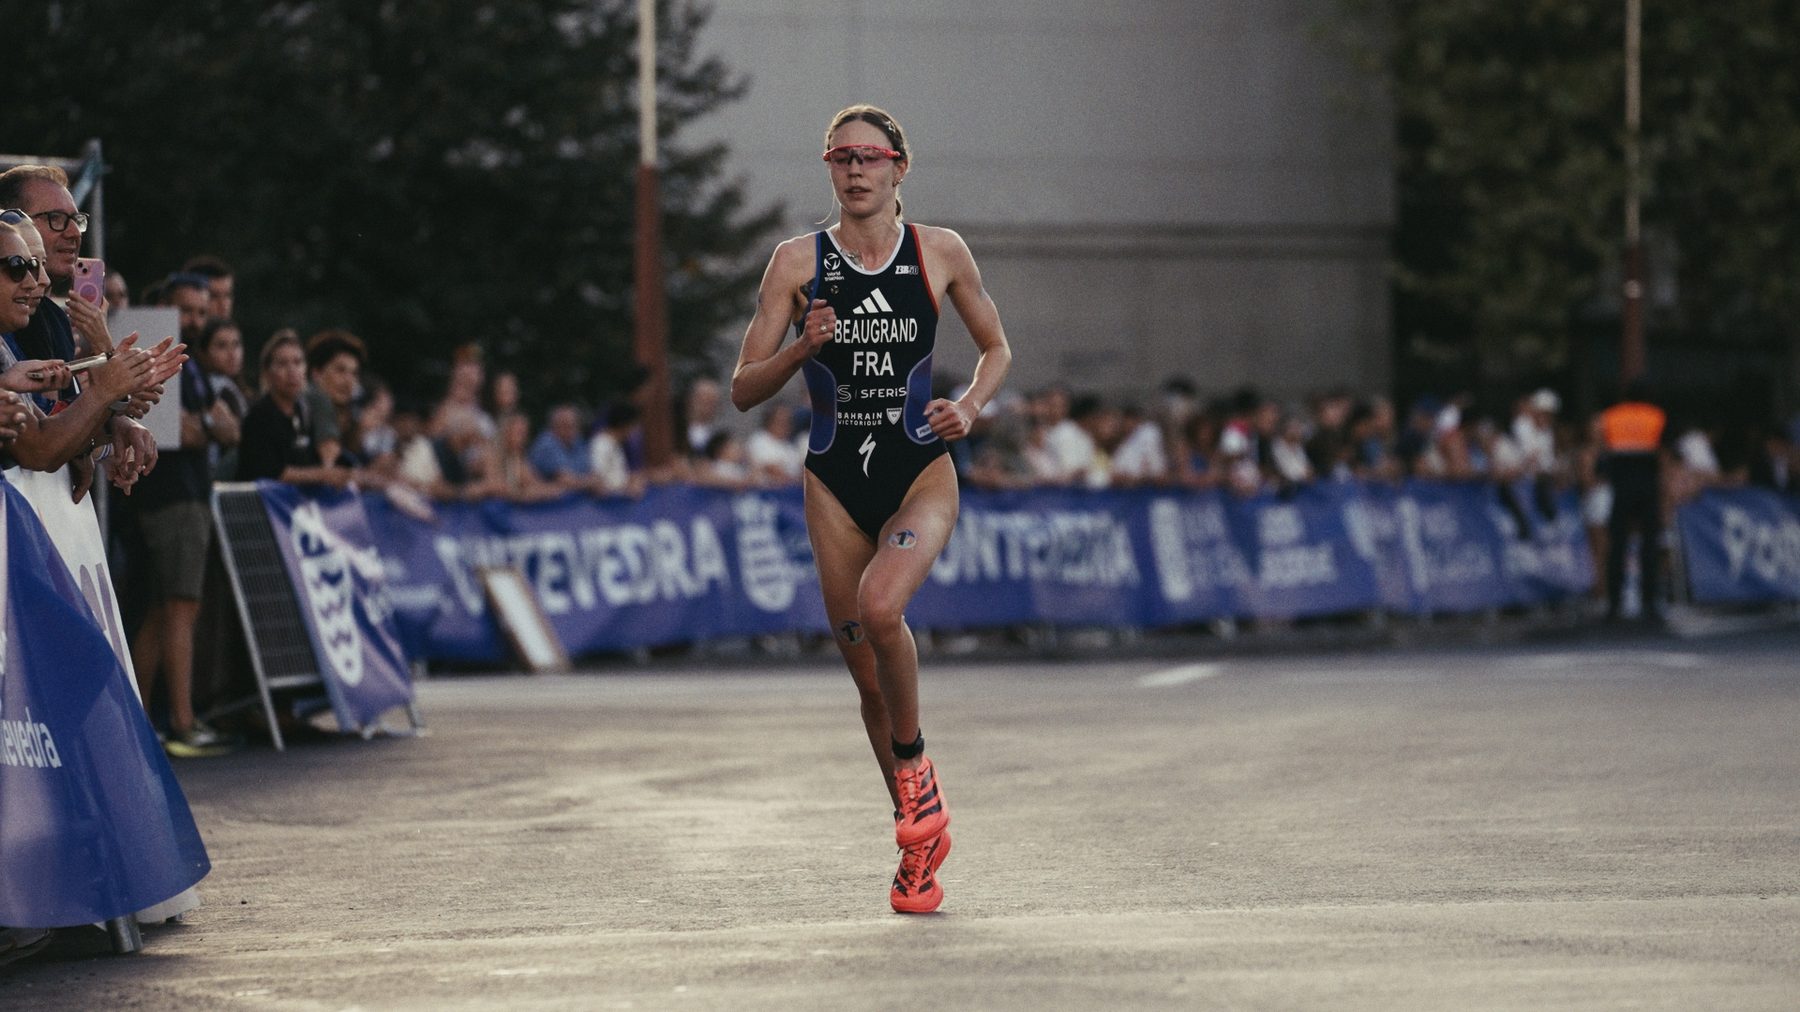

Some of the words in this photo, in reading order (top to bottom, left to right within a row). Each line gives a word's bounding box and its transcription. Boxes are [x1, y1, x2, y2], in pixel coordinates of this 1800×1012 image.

[834, 318, 918, 344] BEAUGRAND
[852, 351, 895, 376] FRA
[837, 412, 883, 420] BAHRAIN
